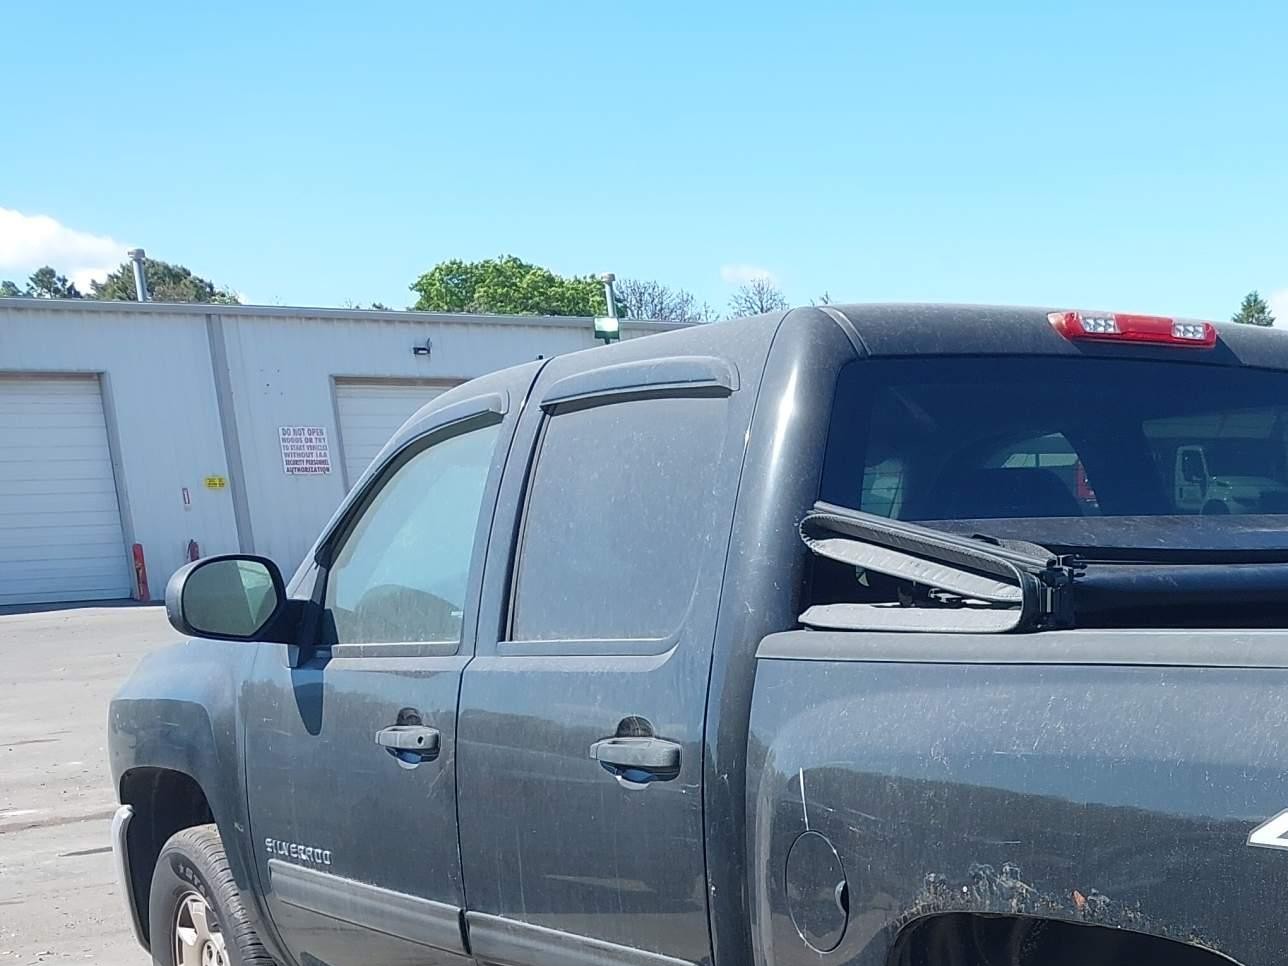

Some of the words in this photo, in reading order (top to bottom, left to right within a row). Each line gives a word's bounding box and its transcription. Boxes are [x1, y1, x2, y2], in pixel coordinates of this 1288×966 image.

[281, 427, 291, 436] DO
[293, 427, 305, 436] NOT
[307, 427, 324, 436] OPEN
[304, 436, 313, 444] OR
[315, 436, 326, 444] TRY
[264, 837, 332, 865] SILVERADO
